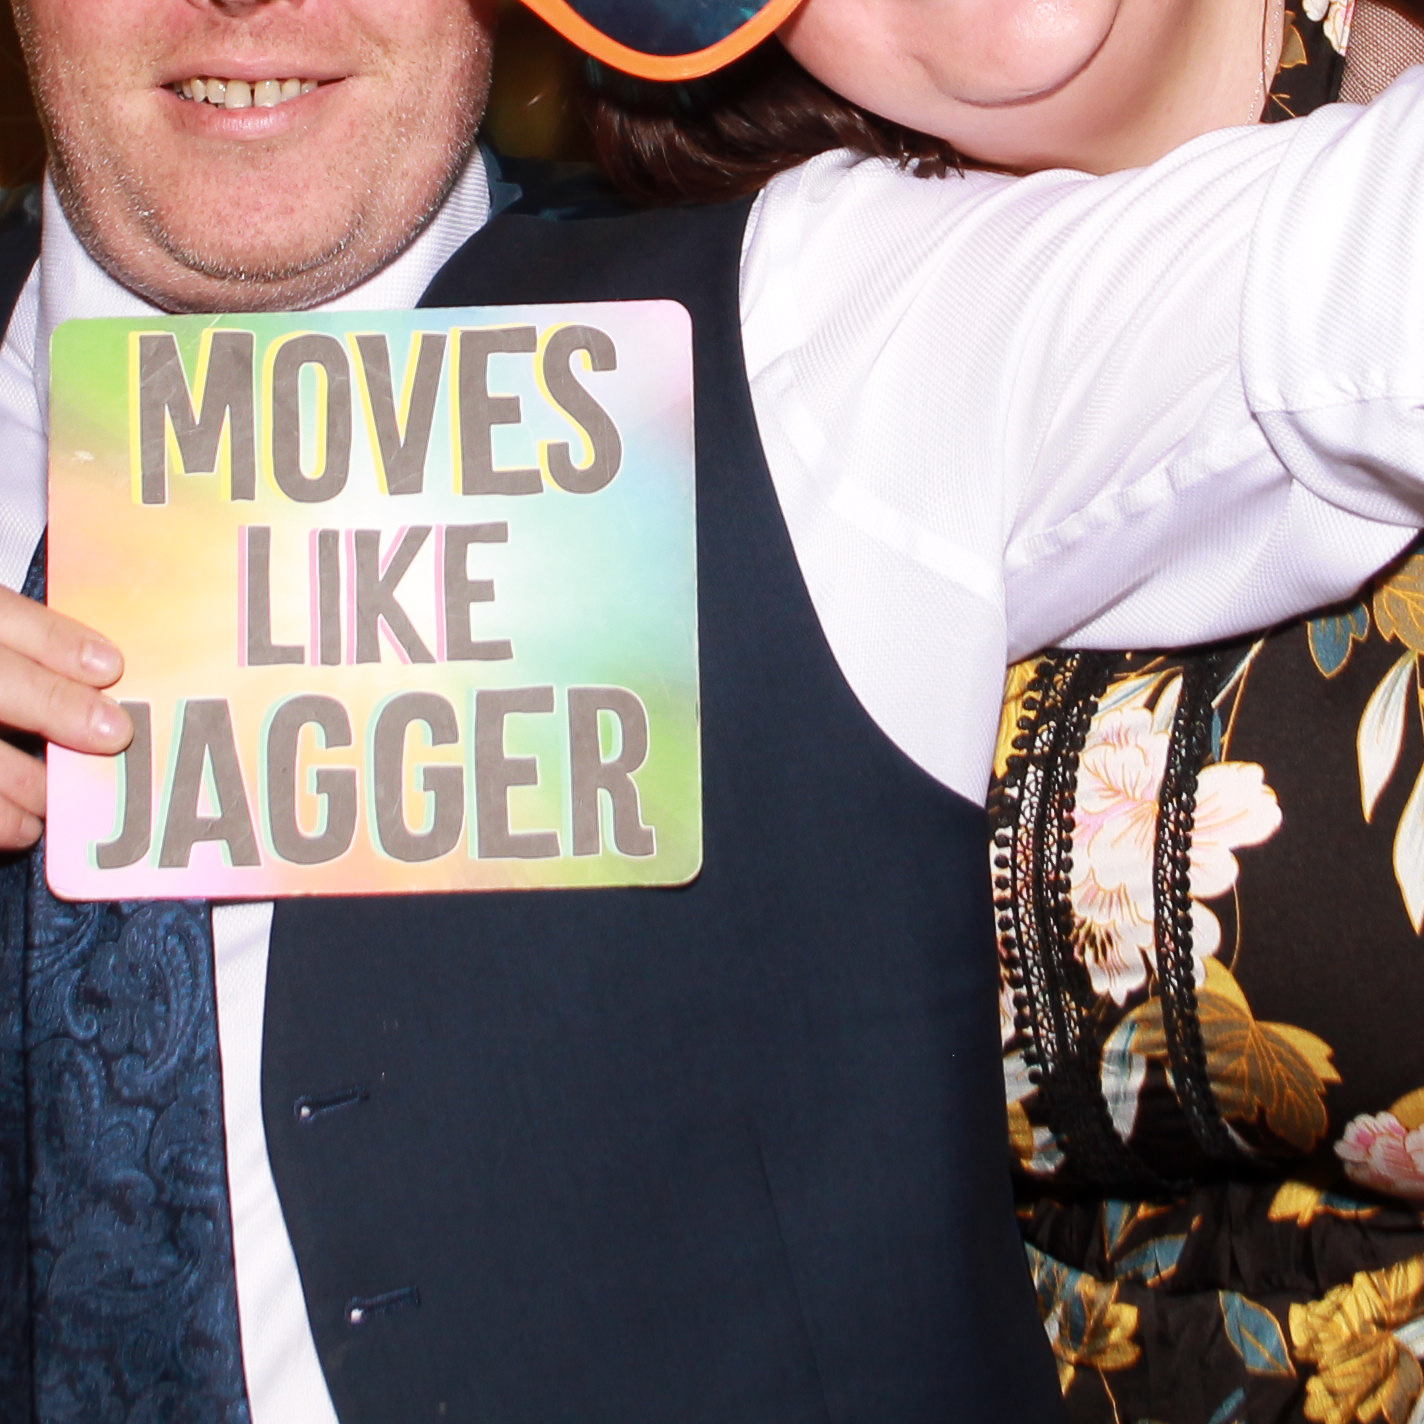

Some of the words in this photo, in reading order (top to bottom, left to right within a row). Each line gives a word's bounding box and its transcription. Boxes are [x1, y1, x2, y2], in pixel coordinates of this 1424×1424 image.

[129, 322, 623, 505] MOVES
[237, 521, 514, 667] LIKE
[87, 685, 656, 869] JAGGER
